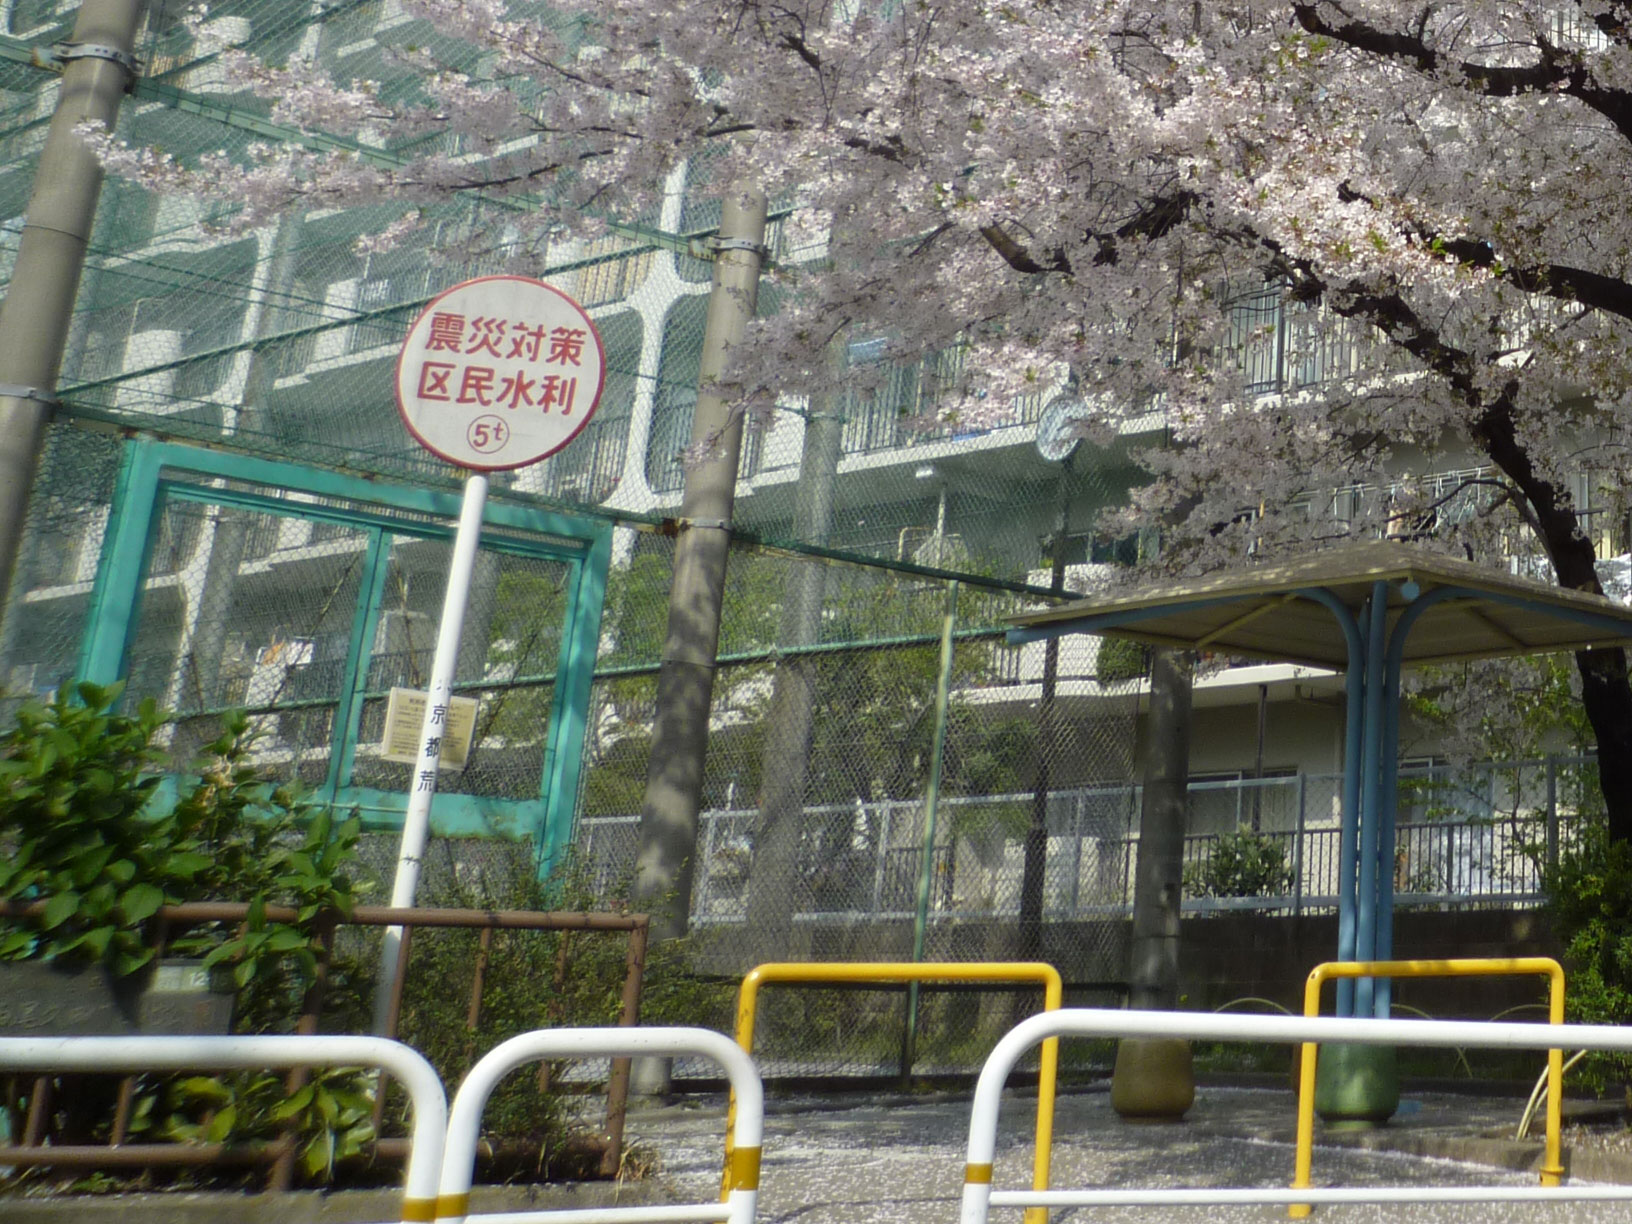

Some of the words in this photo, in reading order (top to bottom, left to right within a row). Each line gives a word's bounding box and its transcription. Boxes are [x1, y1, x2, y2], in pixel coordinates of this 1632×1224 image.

[426, 312, 587, 366] 震災対策
[417, 361, 577, 416] 区民水利
[472, 422, 504, 448] 5t
[418, 685, 450, 792] 京都荒
